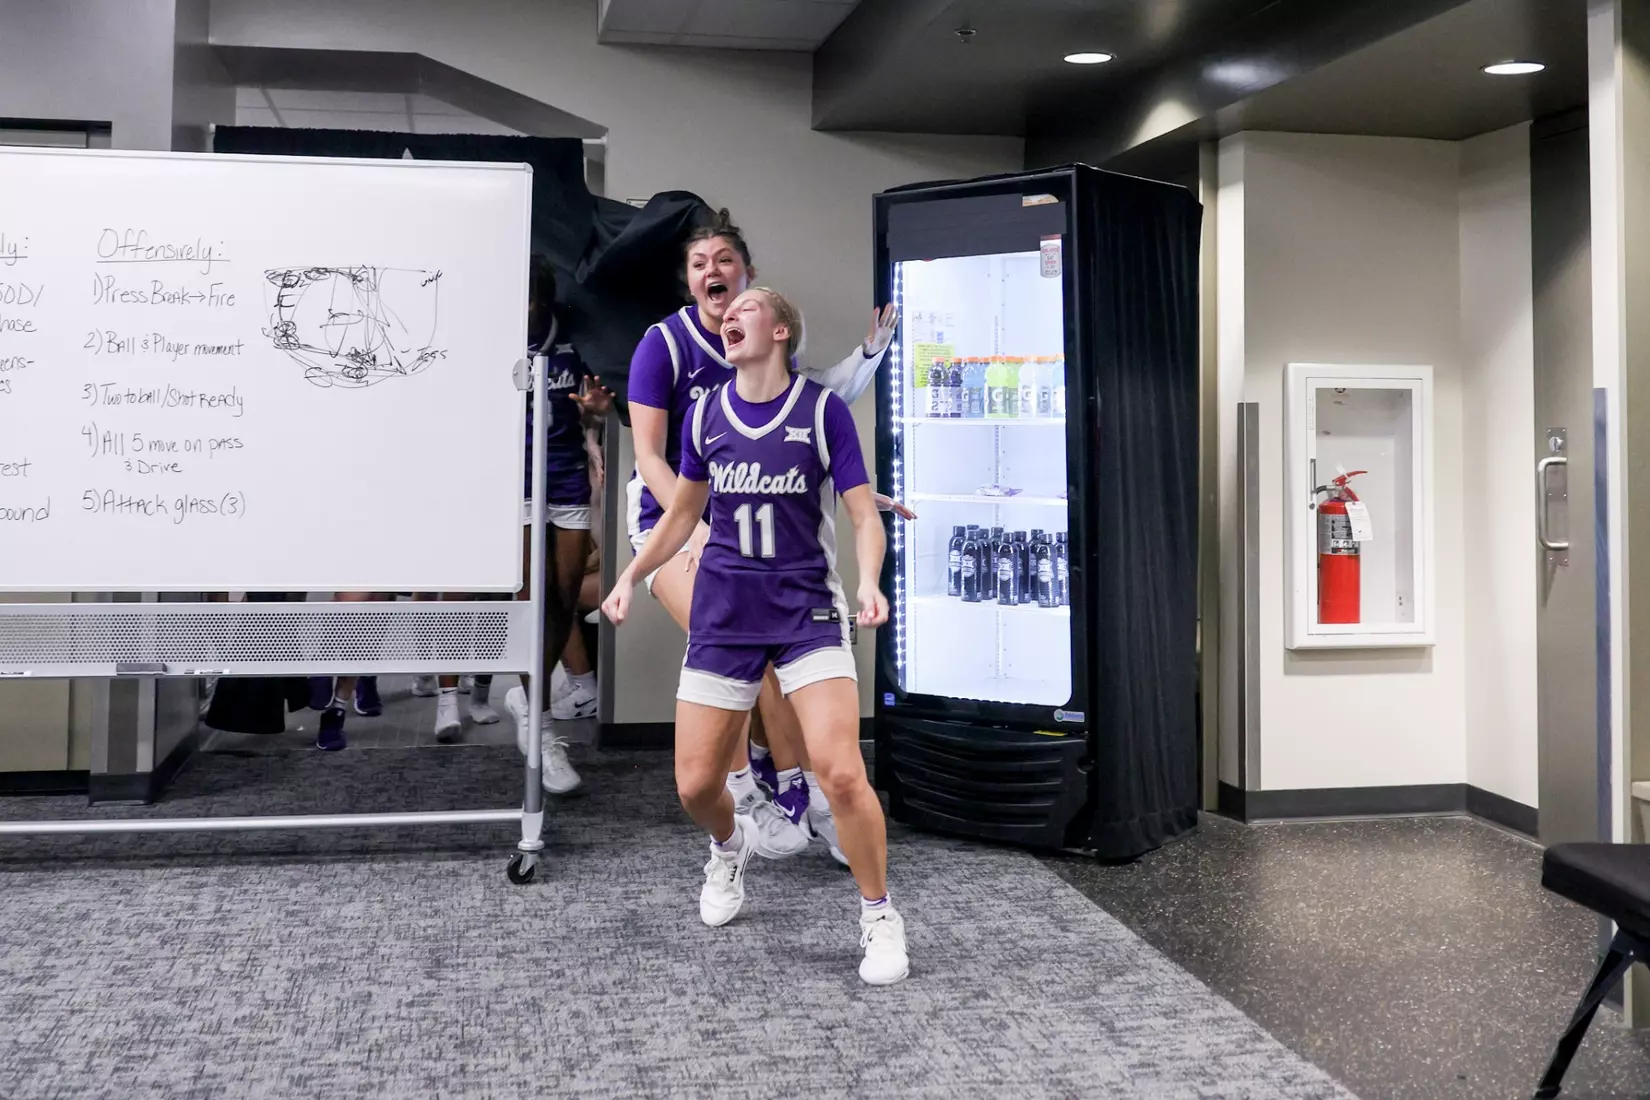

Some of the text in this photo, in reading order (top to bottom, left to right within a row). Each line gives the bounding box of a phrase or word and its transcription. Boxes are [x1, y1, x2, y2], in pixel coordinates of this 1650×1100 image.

[131, 432, 144, 453] 5
[184, 438, 202, 453] on
[137, 459, 184, 475] Drive
[708, 461, 809, 494] Wildcats
[733, 503, 776, 559] 11
